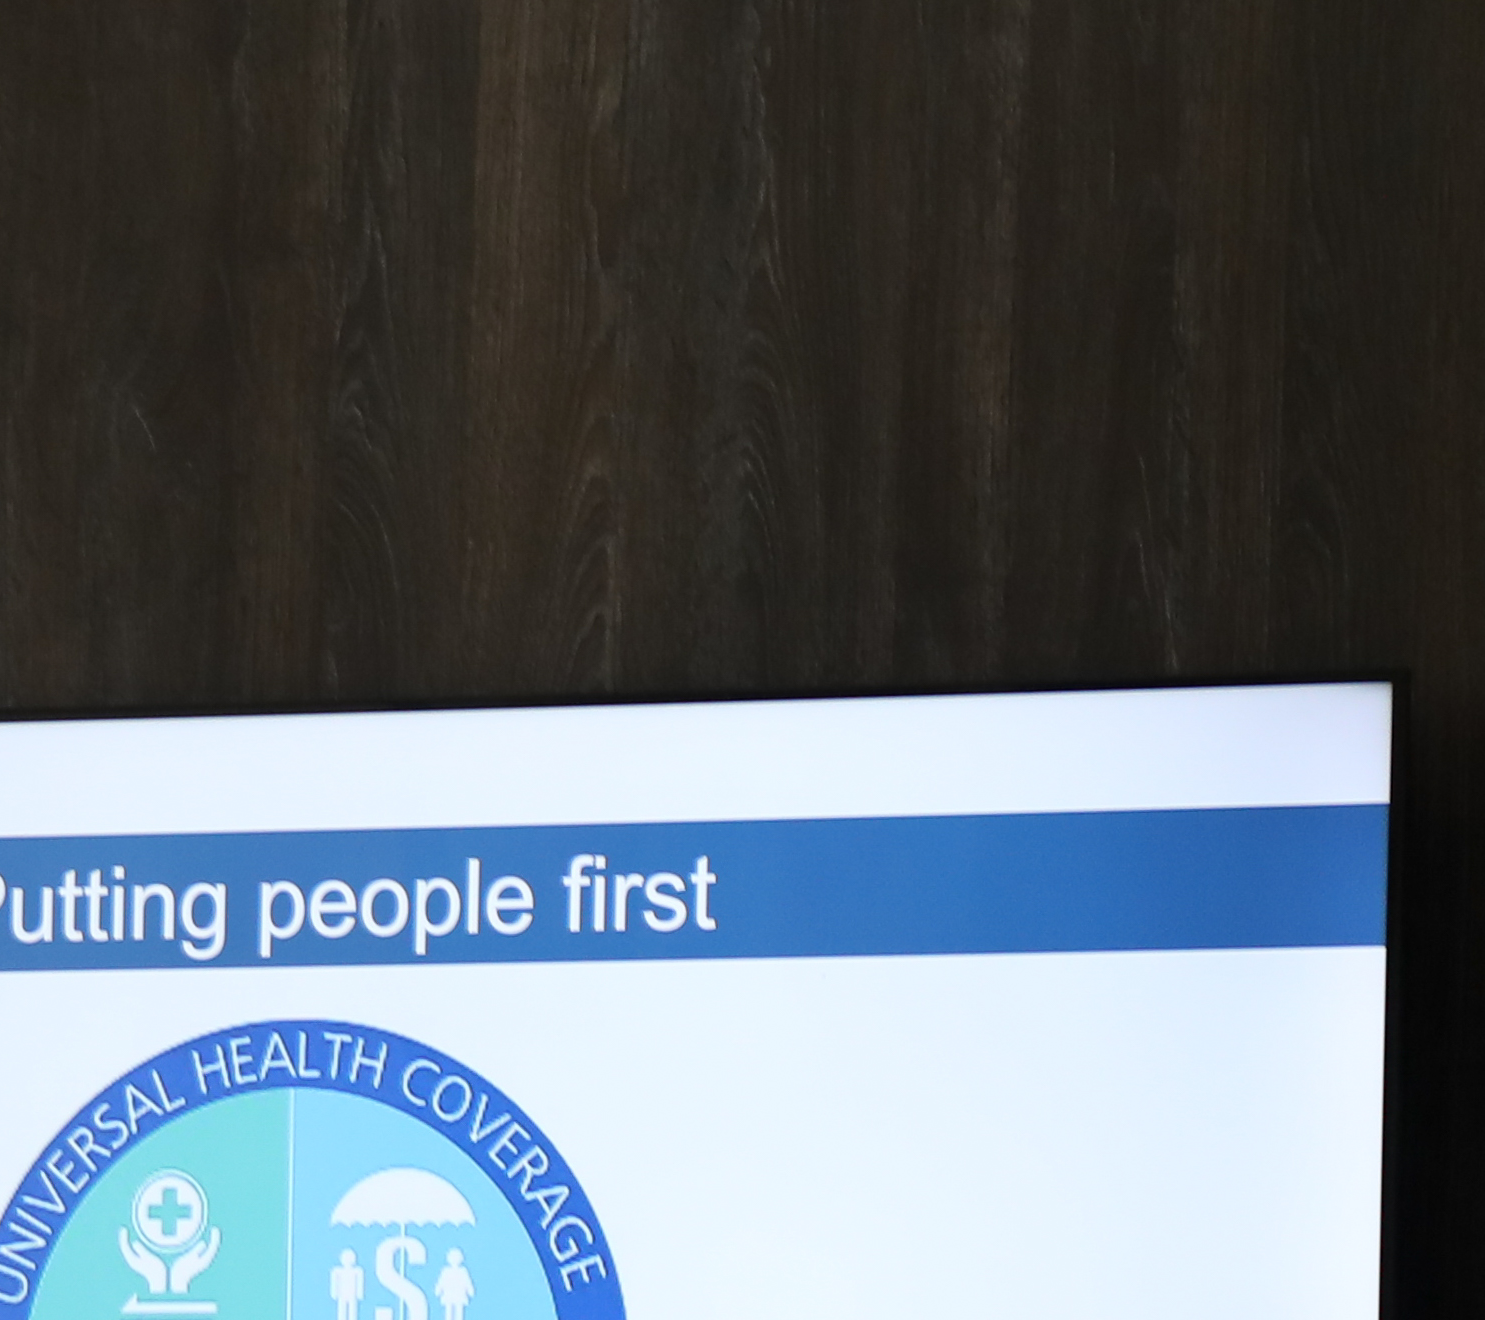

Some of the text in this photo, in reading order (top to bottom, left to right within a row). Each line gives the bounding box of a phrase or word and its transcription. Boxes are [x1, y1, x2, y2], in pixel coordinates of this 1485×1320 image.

[257, 857, 536, 958] people
[561, 853, 719, 933] first
[192, 1030, 387, 1095] HEALTH
[400, 1057, 608, 1294] COVERAGE
